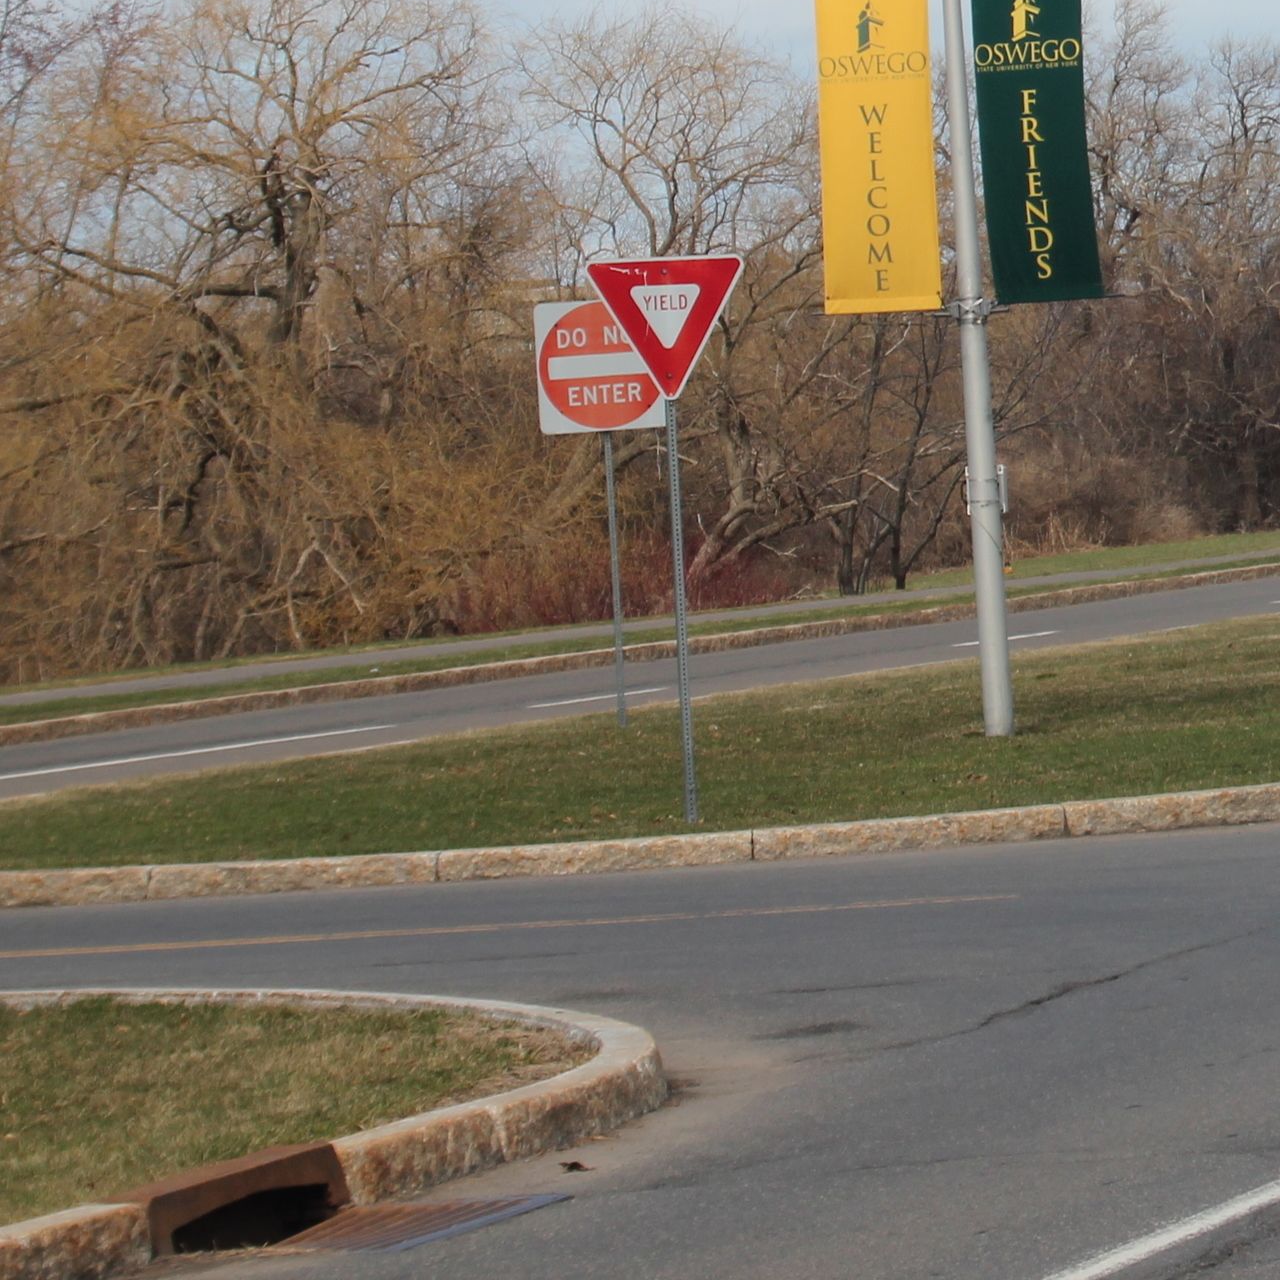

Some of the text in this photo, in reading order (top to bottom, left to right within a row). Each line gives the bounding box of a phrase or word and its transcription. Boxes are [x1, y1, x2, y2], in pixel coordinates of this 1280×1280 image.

[819, 51, 926, 77] OSWEGO
[975, 38, 1080, 65] OSWEGO
[859, 103, 894, 291] WELCOME
[1021, 89, 1053, 279] FRIENDS
[642, 294, 688, 311] YIELD
[556, 327, 587, 350] DO
[567, 382, 643, 407] ENTER
